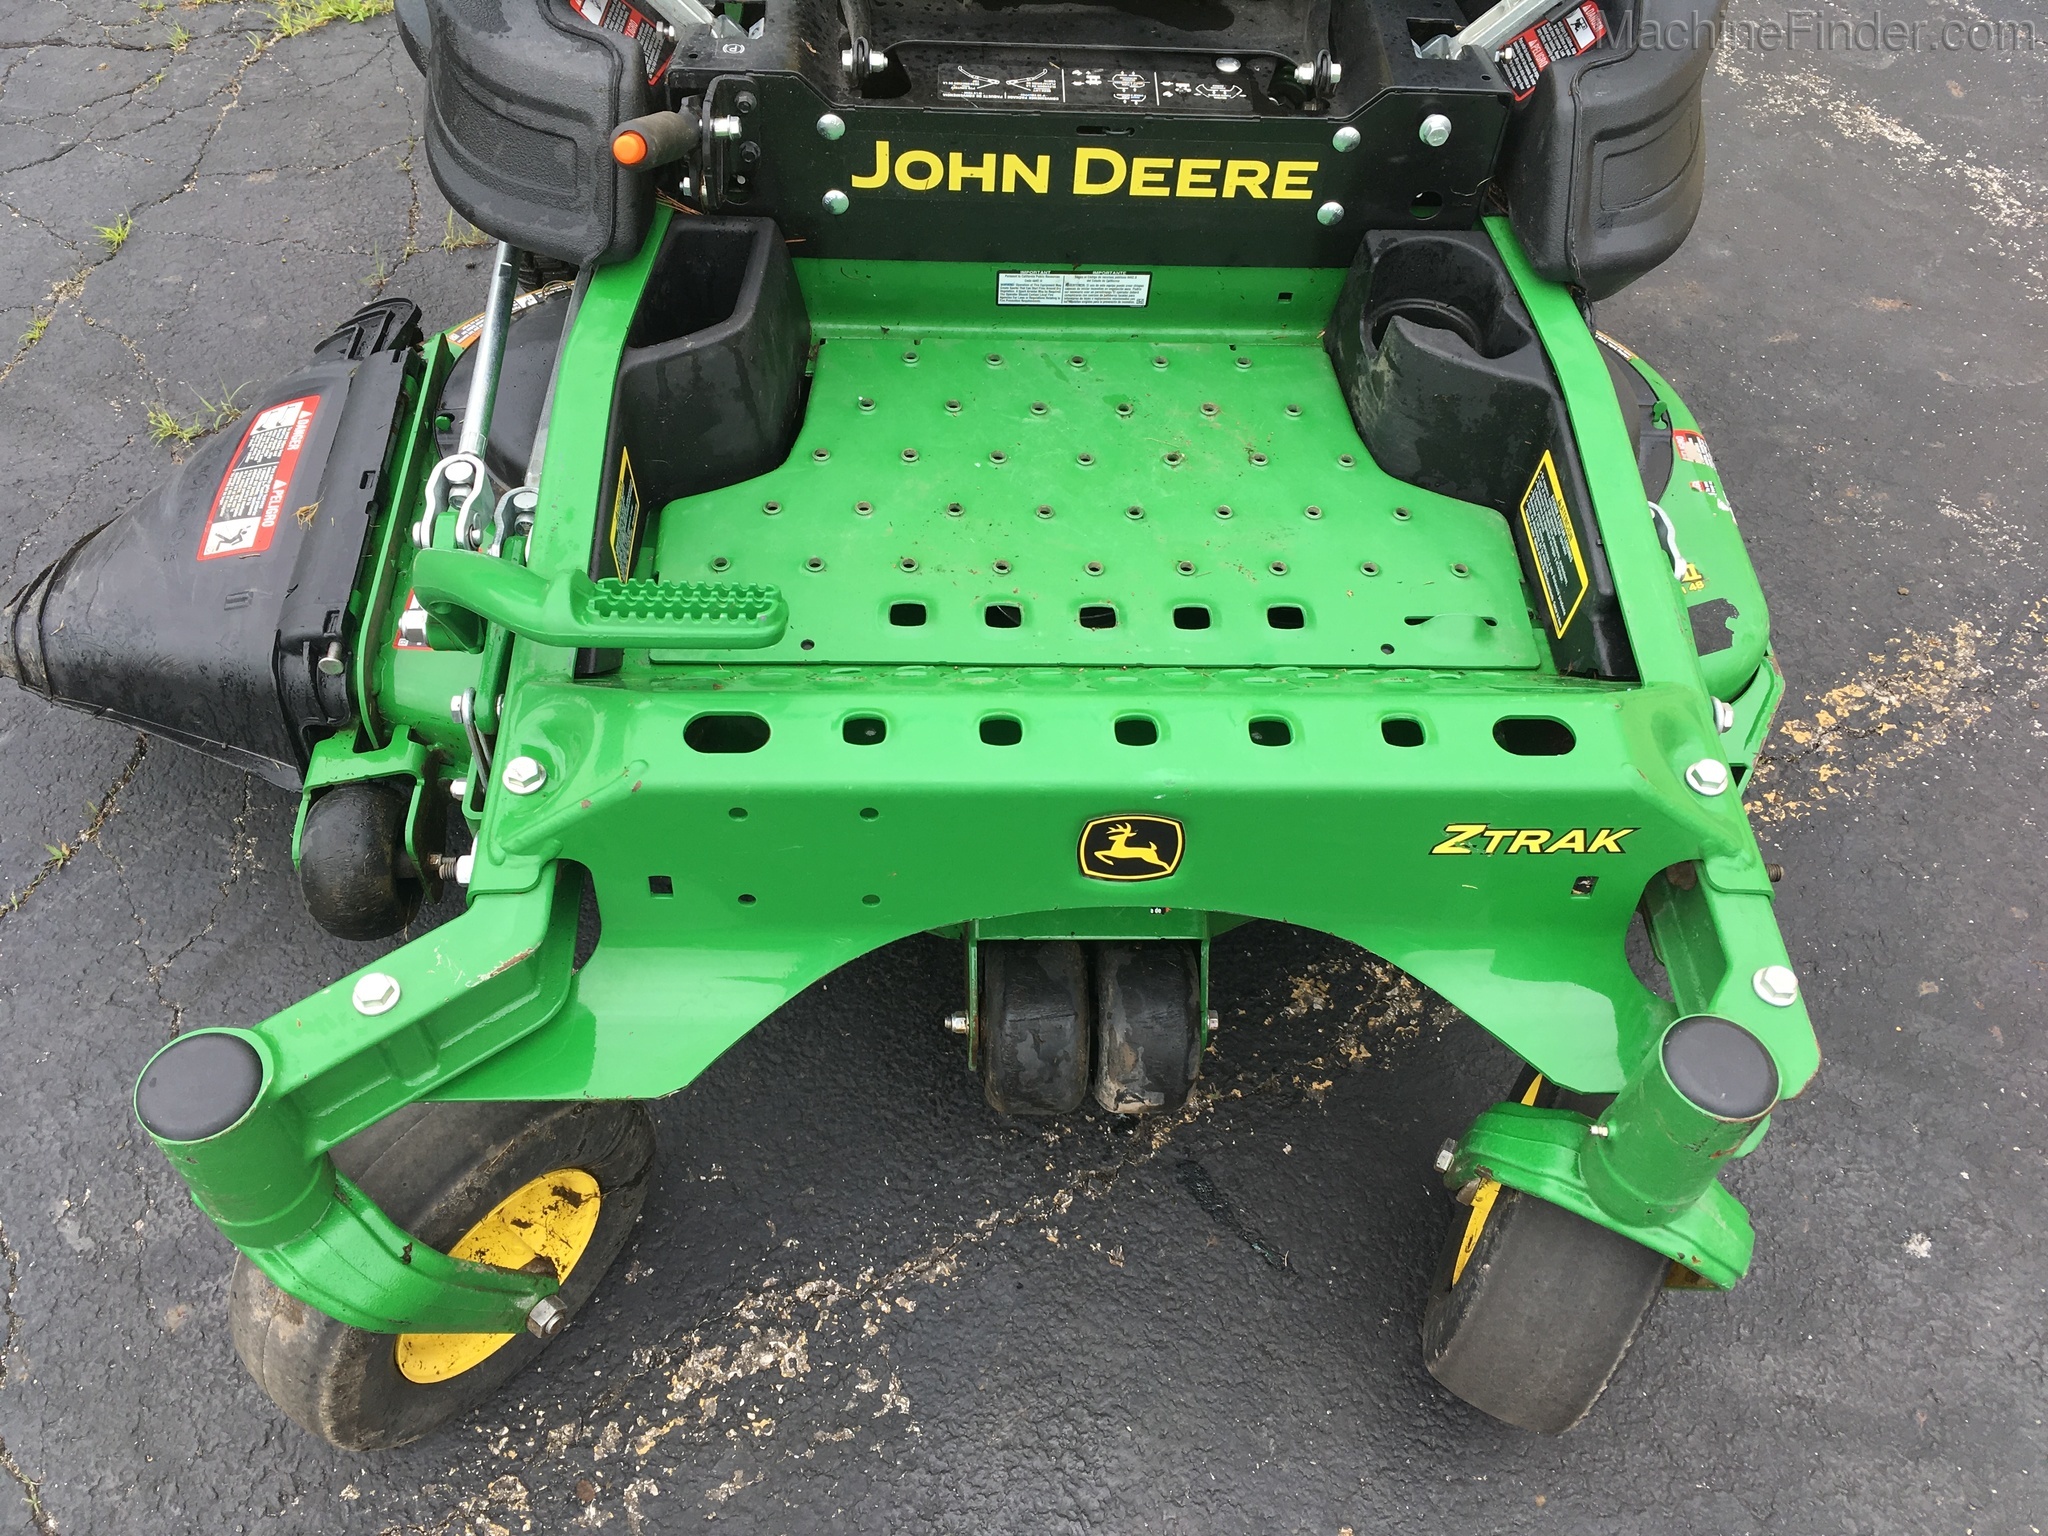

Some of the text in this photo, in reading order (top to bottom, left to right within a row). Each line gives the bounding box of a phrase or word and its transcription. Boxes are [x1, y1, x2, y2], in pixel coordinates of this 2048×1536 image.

[851, 140, 1321, 201] JOHN DEERE
[261, 489, 284, 528] PELIGRO
